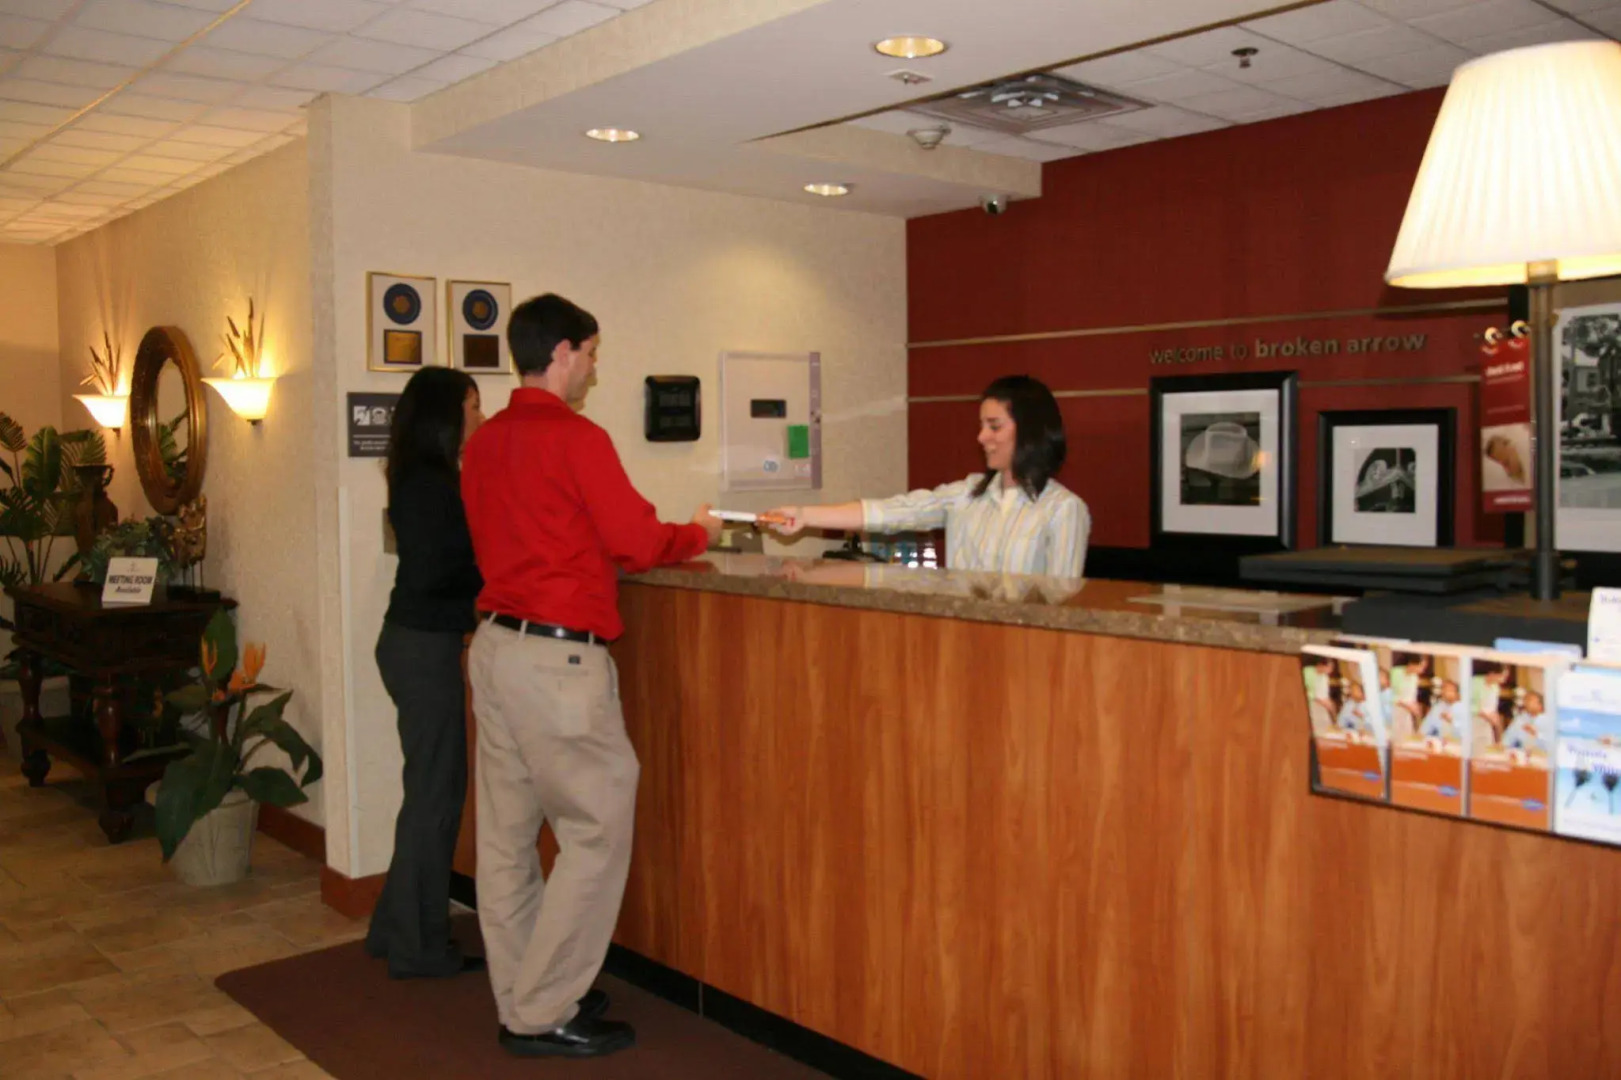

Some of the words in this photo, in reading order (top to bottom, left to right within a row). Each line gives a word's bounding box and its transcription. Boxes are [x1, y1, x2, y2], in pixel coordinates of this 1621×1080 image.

[1149, 345, 1224, 365] welcome
[1230, 343, 1248, 359] to
[1255, 337, 1340, 358] broken
[1346, 333, 1426, 353] arrow
[109, 575, 134, 584] MEETING
[135, 575, 152, 584] ROOM
